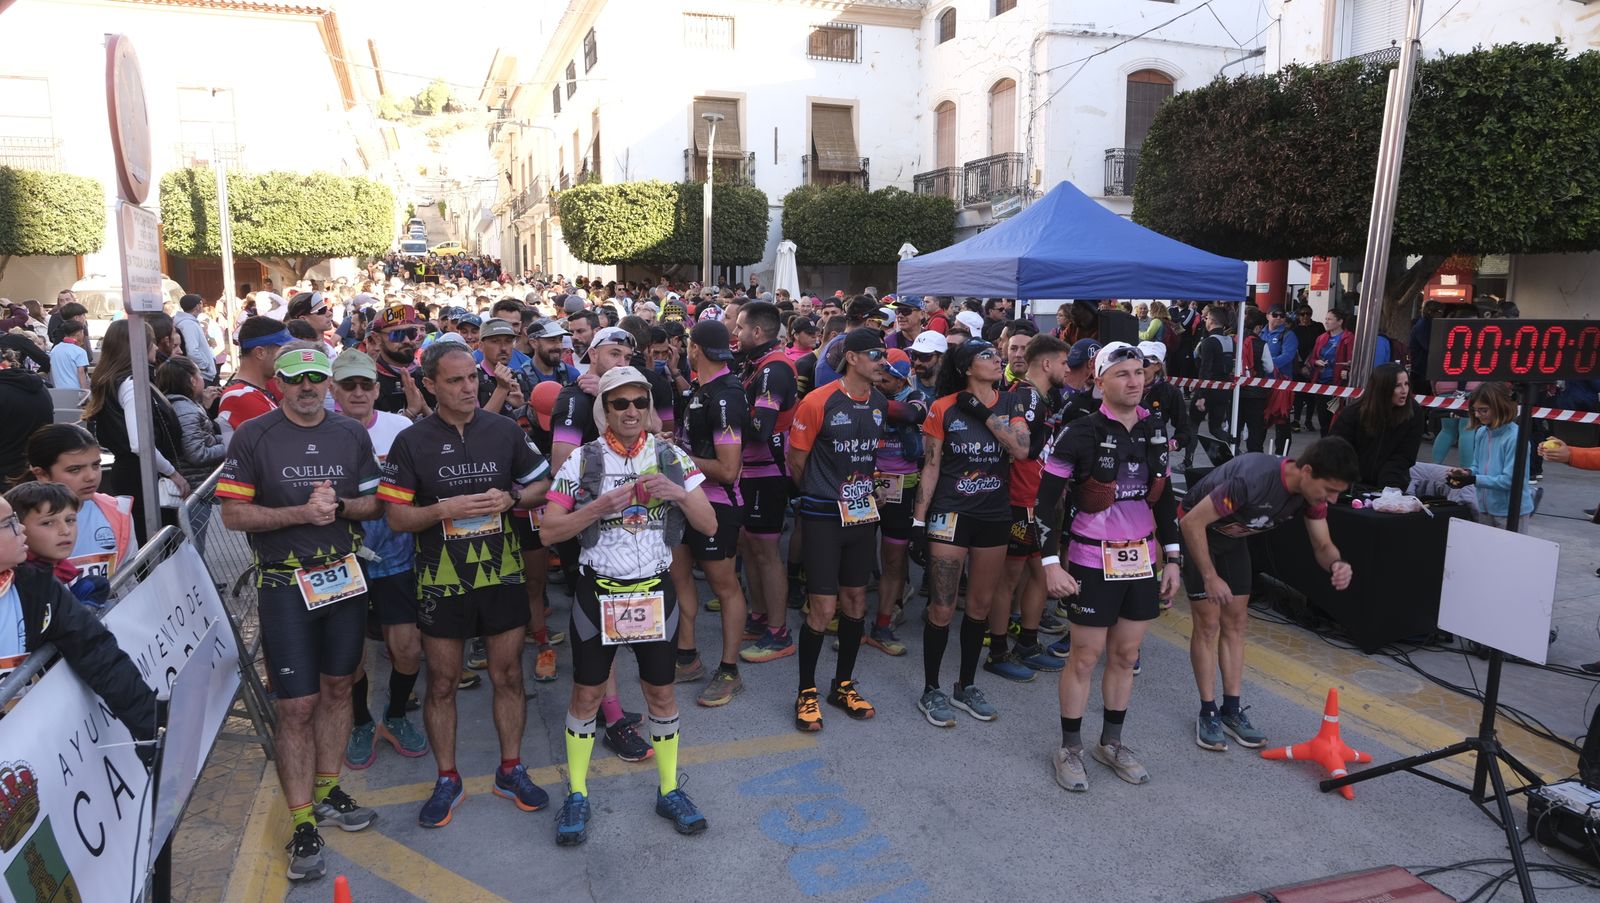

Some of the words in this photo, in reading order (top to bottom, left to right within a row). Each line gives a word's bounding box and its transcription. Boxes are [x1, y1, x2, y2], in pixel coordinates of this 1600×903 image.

[282, 464, 345, 479] CUELLAR
[438, 461, 499, 478] CUELLAR
[957, 476, 1001, 494] Sigfrido
[848, 497, 870, 511] 256
[1117, 549, 1139, 562] 93
[310, 565, 349, 587] 381
[186, 584, 203, 615] DE
[619, 607, 646, 623] 43
